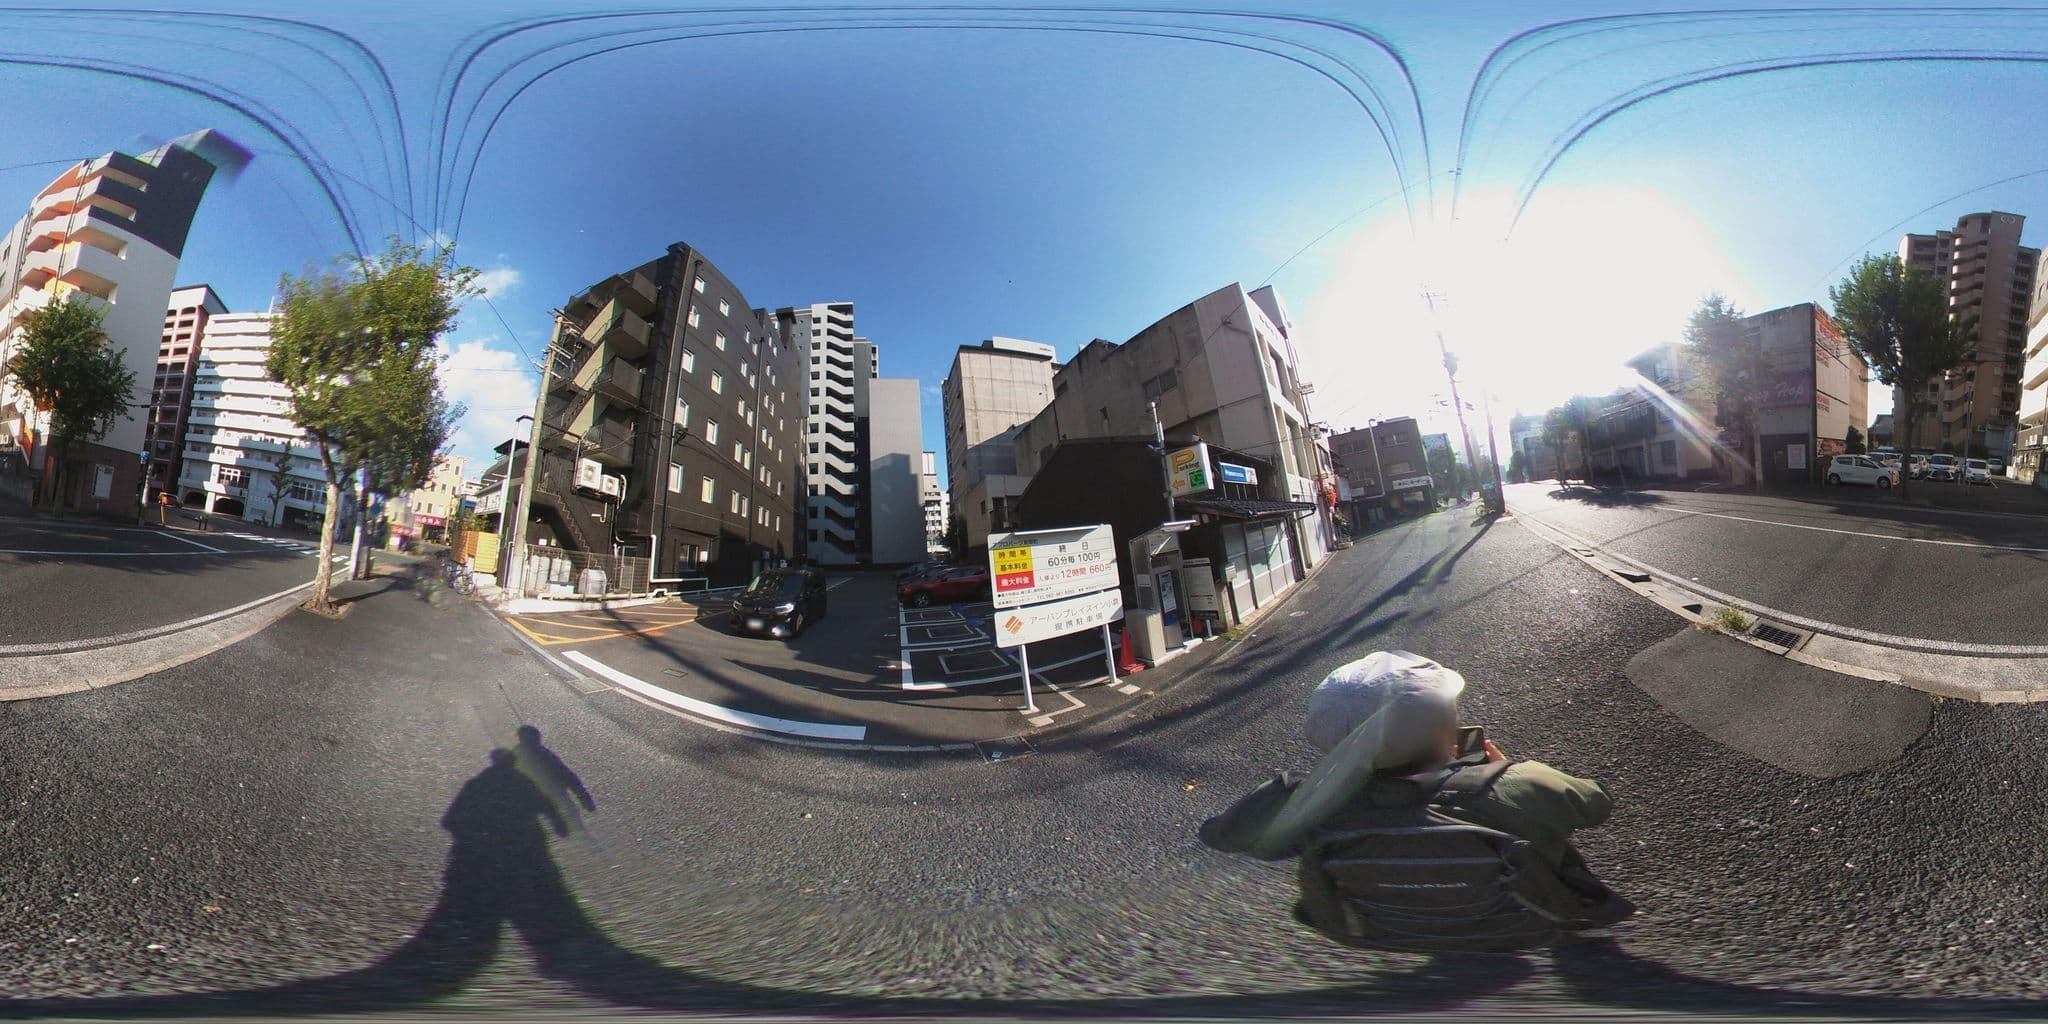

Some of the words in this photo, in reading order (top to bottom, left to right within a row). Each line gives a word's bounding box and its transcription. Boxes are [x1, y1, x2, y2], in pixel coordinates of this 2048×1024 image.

[998, 549, 1027, 559] 時間帯
[1047, 555, 1075, 567] 60分毎
[1078, 551, 1101, 563] 100円
[1000, 562, 1028, 572] 基本料金
[1089, 562, 1112, 574] 660円
[1001, 578, 1030, 587] 最大料金
